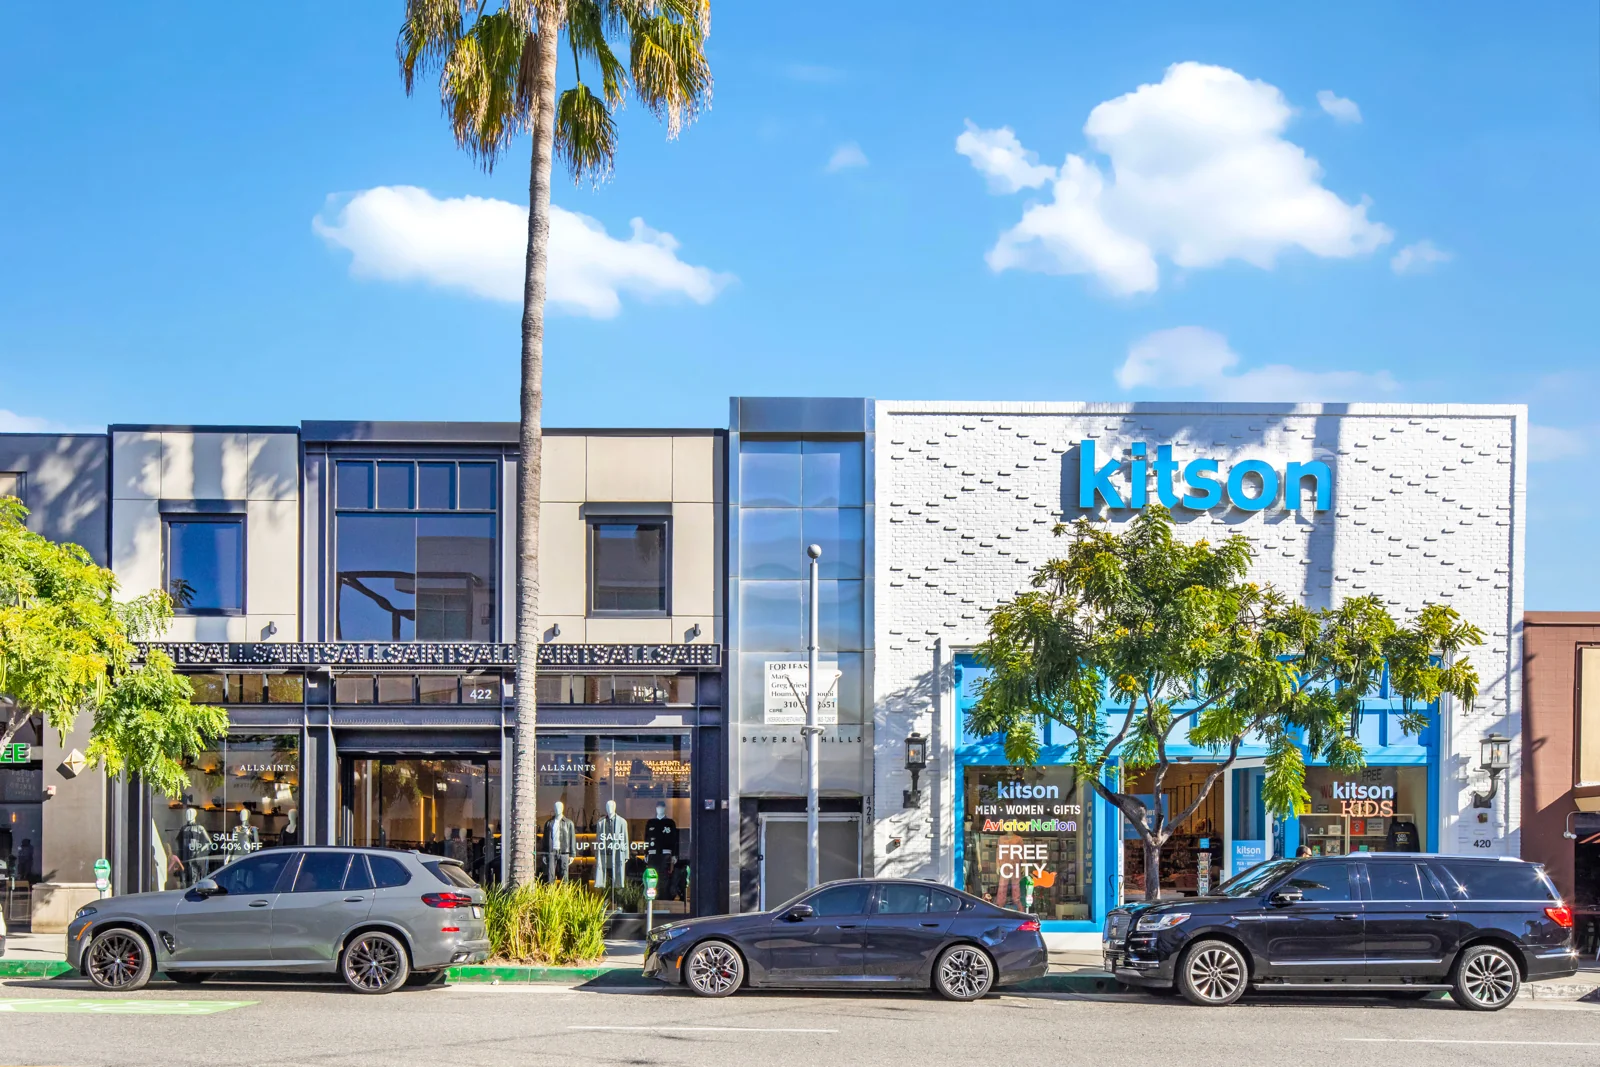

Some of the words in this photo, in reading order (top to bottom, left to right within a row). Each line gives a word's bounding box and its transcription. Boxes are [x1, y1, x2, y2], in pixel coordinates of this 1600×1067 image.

[1080, 439, 1332, 511] kitson
[470, 689, 492, 700] 422
[240, 764, 296, 772] ALLSAINTS
[541, 764, 596, 772] ALLSAINTS
[998, 781, 1059, 799] kitson
[1333, 781, 1394, 799] kitson
[975, 805, 997, 815] MEN
[1006, 805, 1044, 815] WOMEN
[1053, 805, 1081, 815] GIFTS
[1341, 800, 1394, 817] KIDS
[983, 819, 1077, 832] AviatorNation
[213, 833, 239, 842] SALE
[600, 833, 625, 841] SALE
[188, 842, 203, 851] UP
[220, 842, 241, 851] 40%
[244, 842, 263, 851] OFF
[576, 842, 590, 851] UP
[591, 842, 606, 851] TO
[630, 842, 650, 851] OFF
[1473, 839, 1491, 848] 420
[998, 844, 1048, 860] FREE
[1236, 845, 1261, 855] kitson
[1000, 863, 1048, 878] CITY
